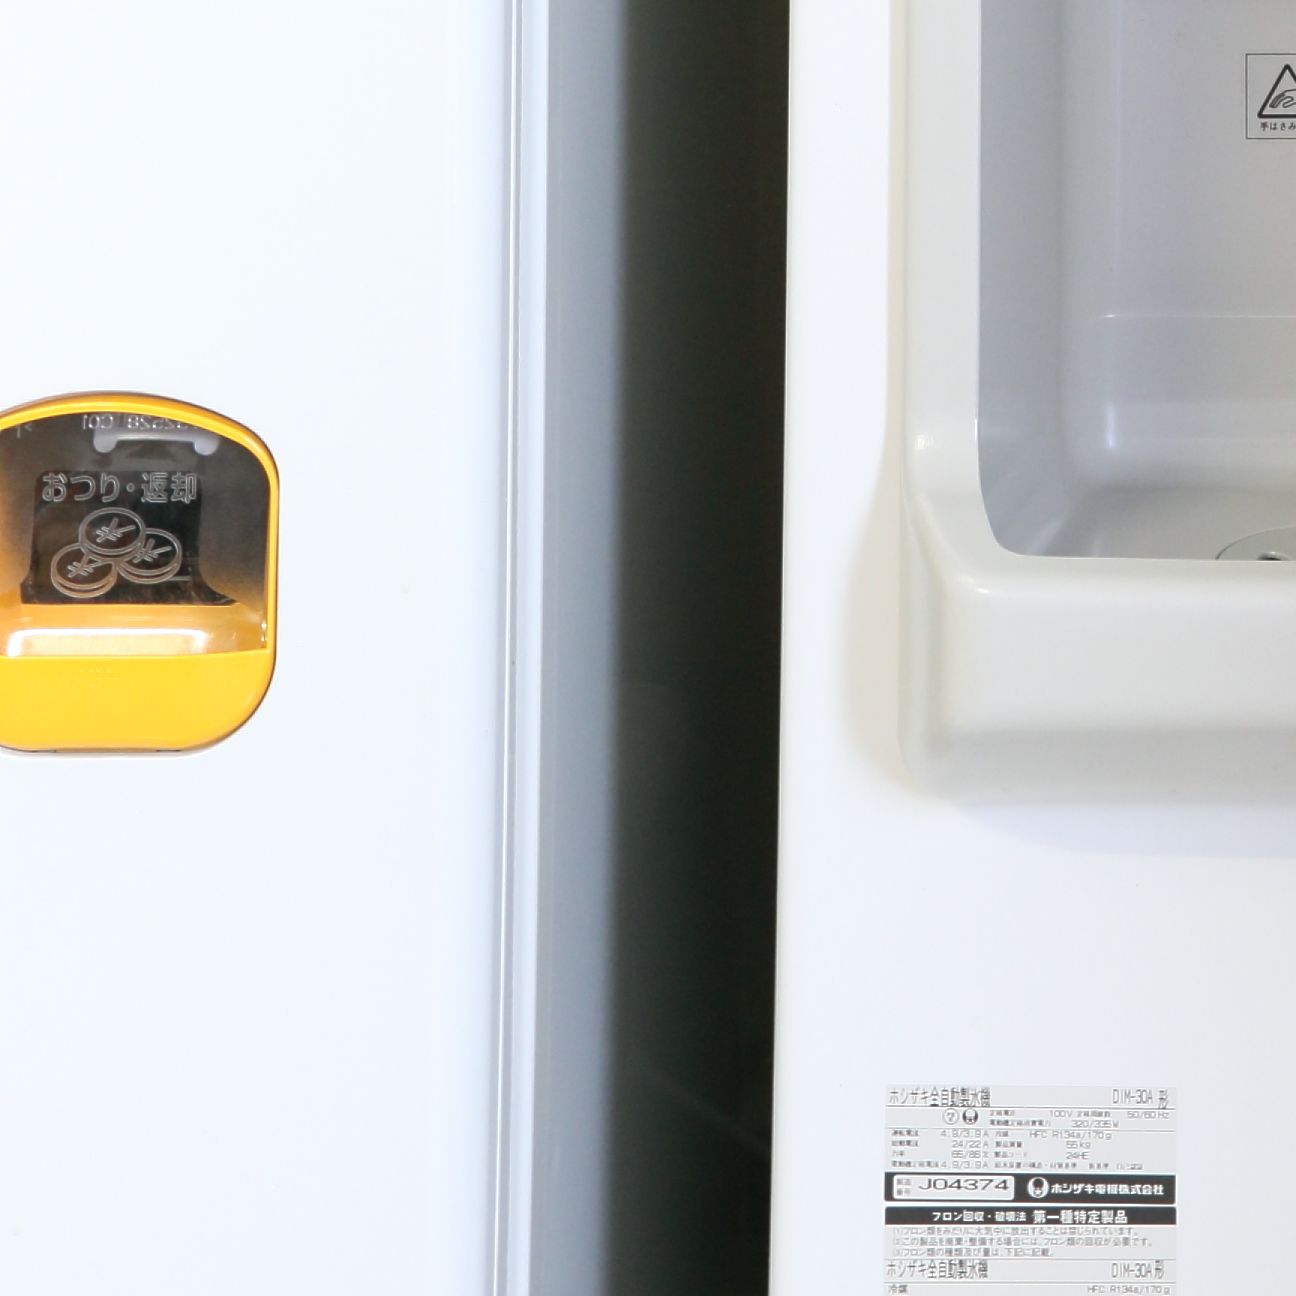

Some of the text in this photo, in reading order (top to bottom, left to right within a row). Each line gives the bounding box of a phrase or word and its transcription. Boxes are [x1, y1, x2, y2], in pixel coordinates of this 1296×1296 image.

[41, 471, 199, 504] おつり・返却
[1112, 1088, 1153, 1105] DIM-30A
[918, 1178, 1009, 1191] J04374
[1032, 1209, 1128, 1224] 第一種特定製品
[1111, 1262, 1153, 1279] DIM-30A
